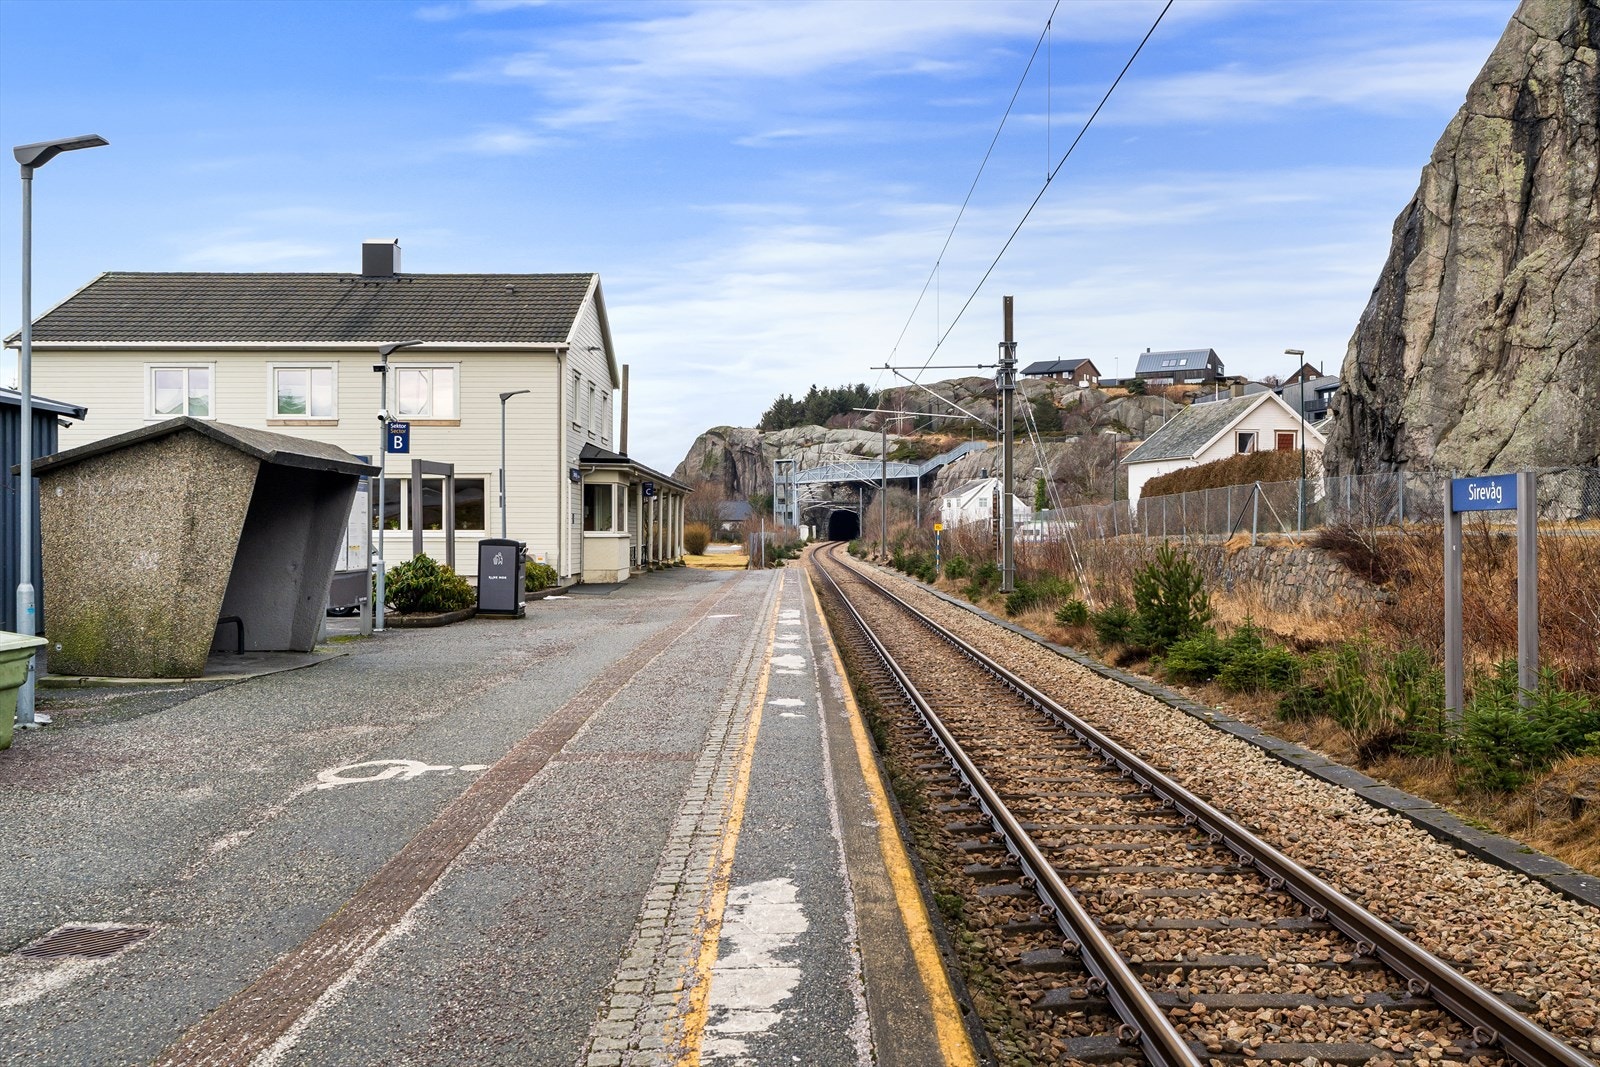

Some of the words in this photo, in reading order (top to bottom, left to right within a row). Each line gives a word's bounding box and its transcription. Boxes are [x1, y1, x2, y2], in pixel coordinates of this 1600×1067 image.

[393, 435, 403, 449] B
[645, 488, 652, 496] C
[1468, 481, 1502, 503] Sirevåg
